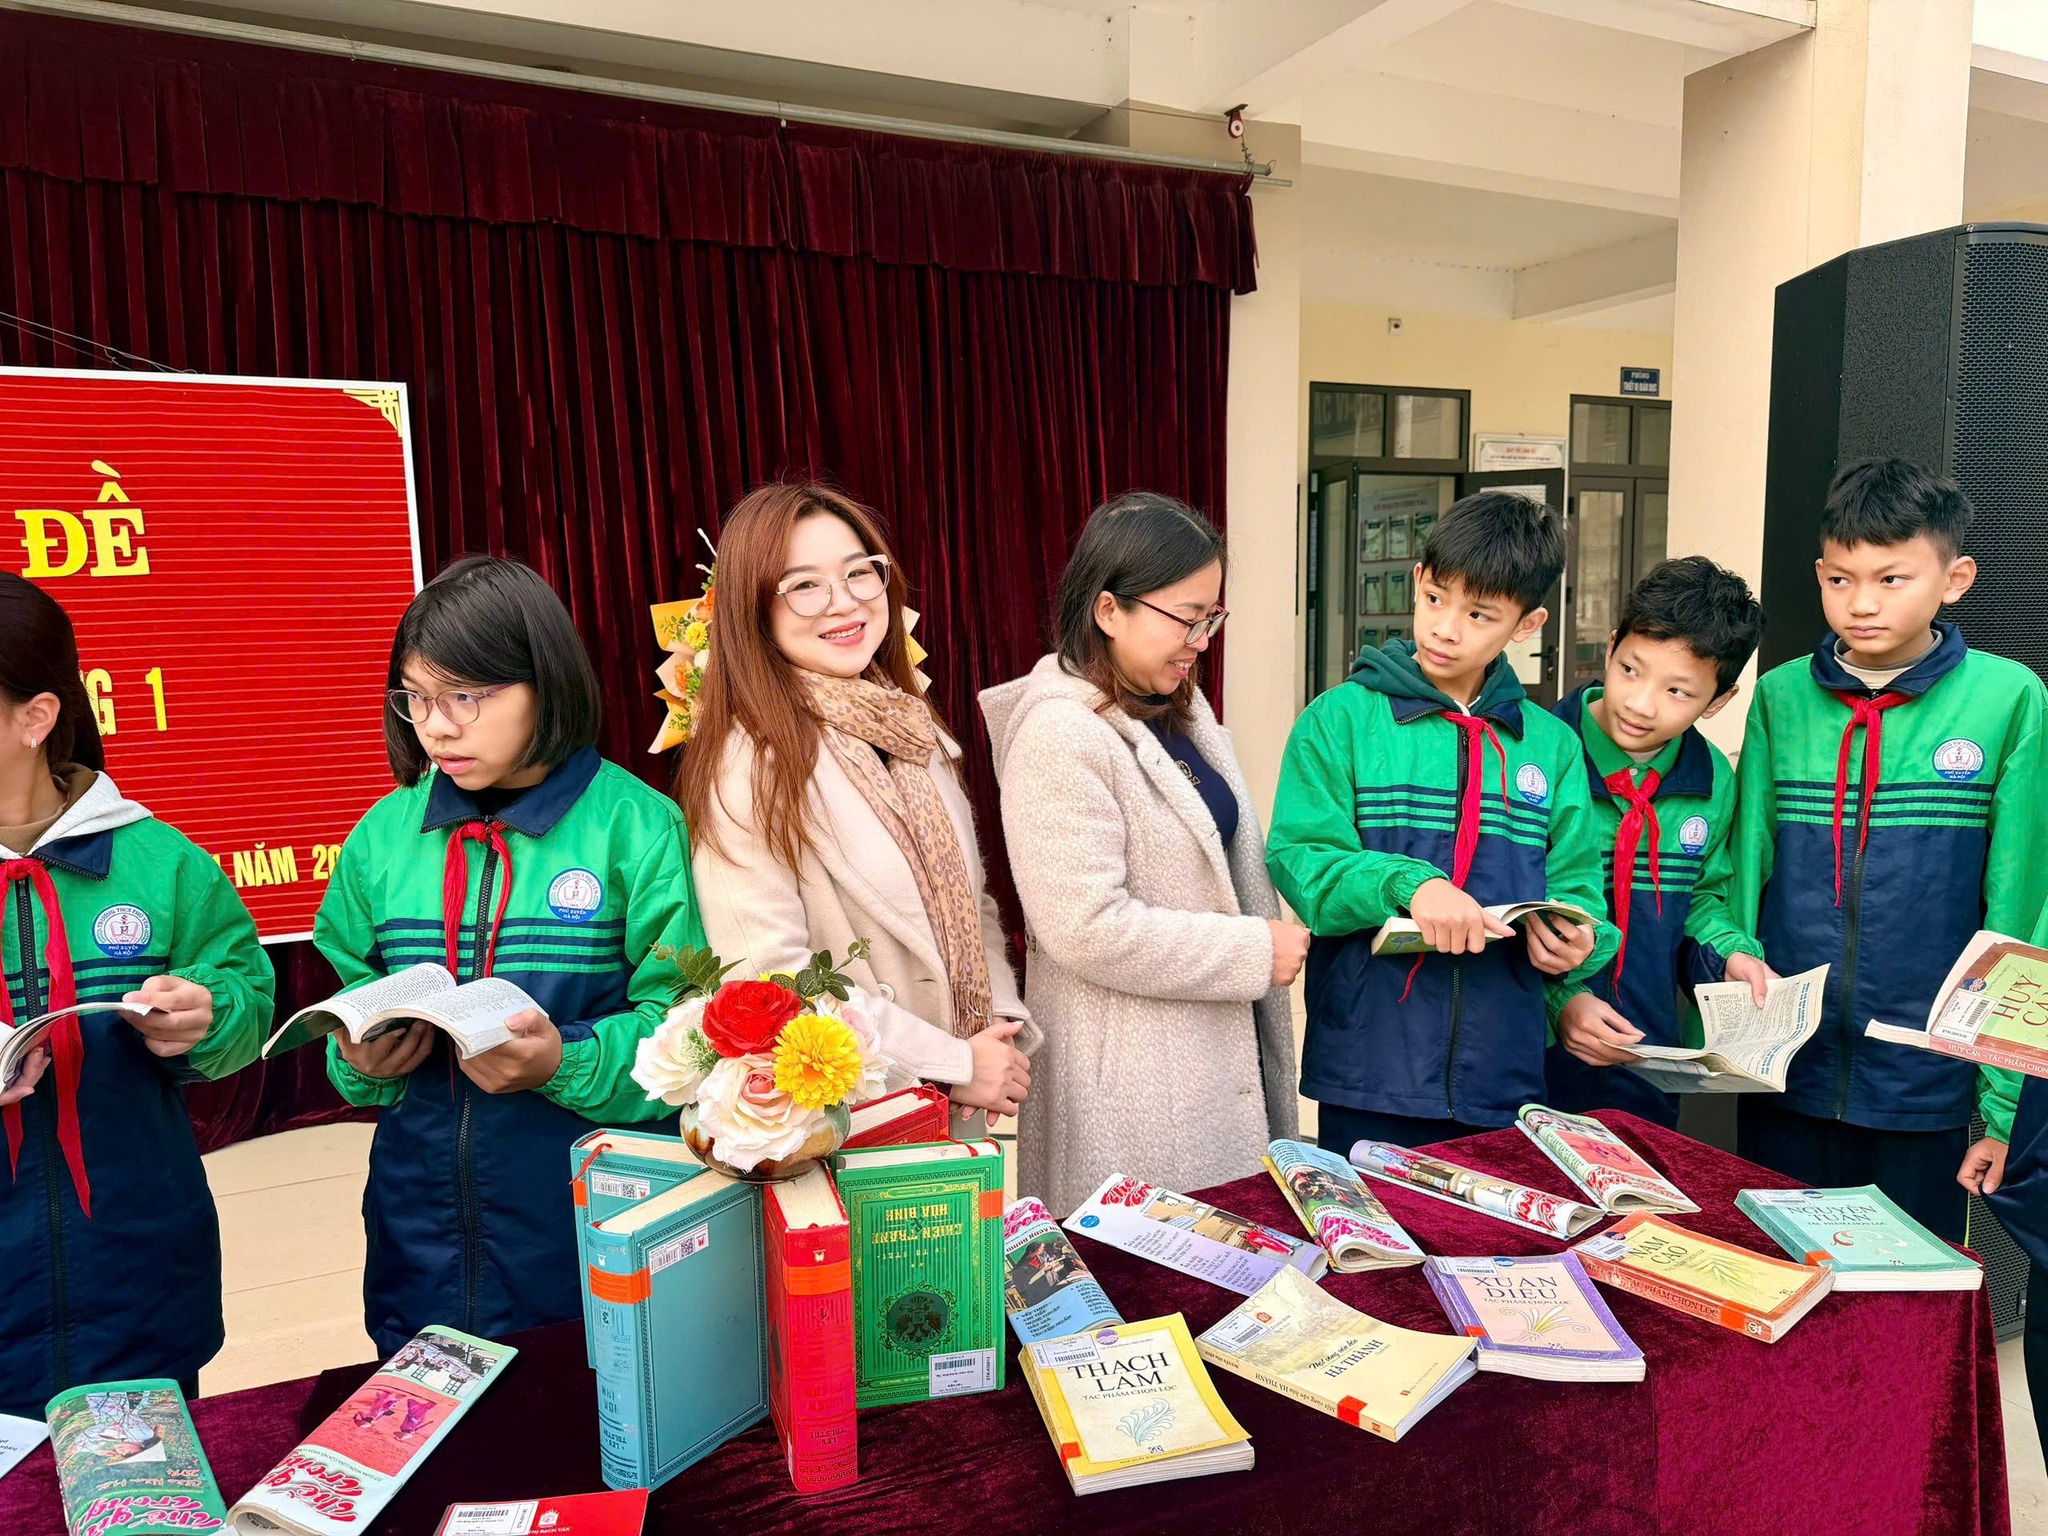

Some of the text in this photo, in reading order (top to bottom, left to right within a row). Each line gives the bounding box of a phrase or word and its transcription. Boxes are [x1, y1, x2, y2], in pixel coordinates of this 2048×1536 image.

[14, 459, 150, 578] ĐỀ
[145, 667, 168, 732] 1
[233, 842, 298, 888] NĂM
[1992, 974, 2042, 1020] HUY
[1948, 1044, 1965, 1053] HUY
[1630, 1235, 1670, 1259] NAM
[1651, 1245, 1688, 1265] CAO
[1068, 1351, 1171, 1379] THẠCH
[1324, 1338, 1384, 1379] HÀ THÀNH
[1096, 1370, 1165, 1393] LAM
